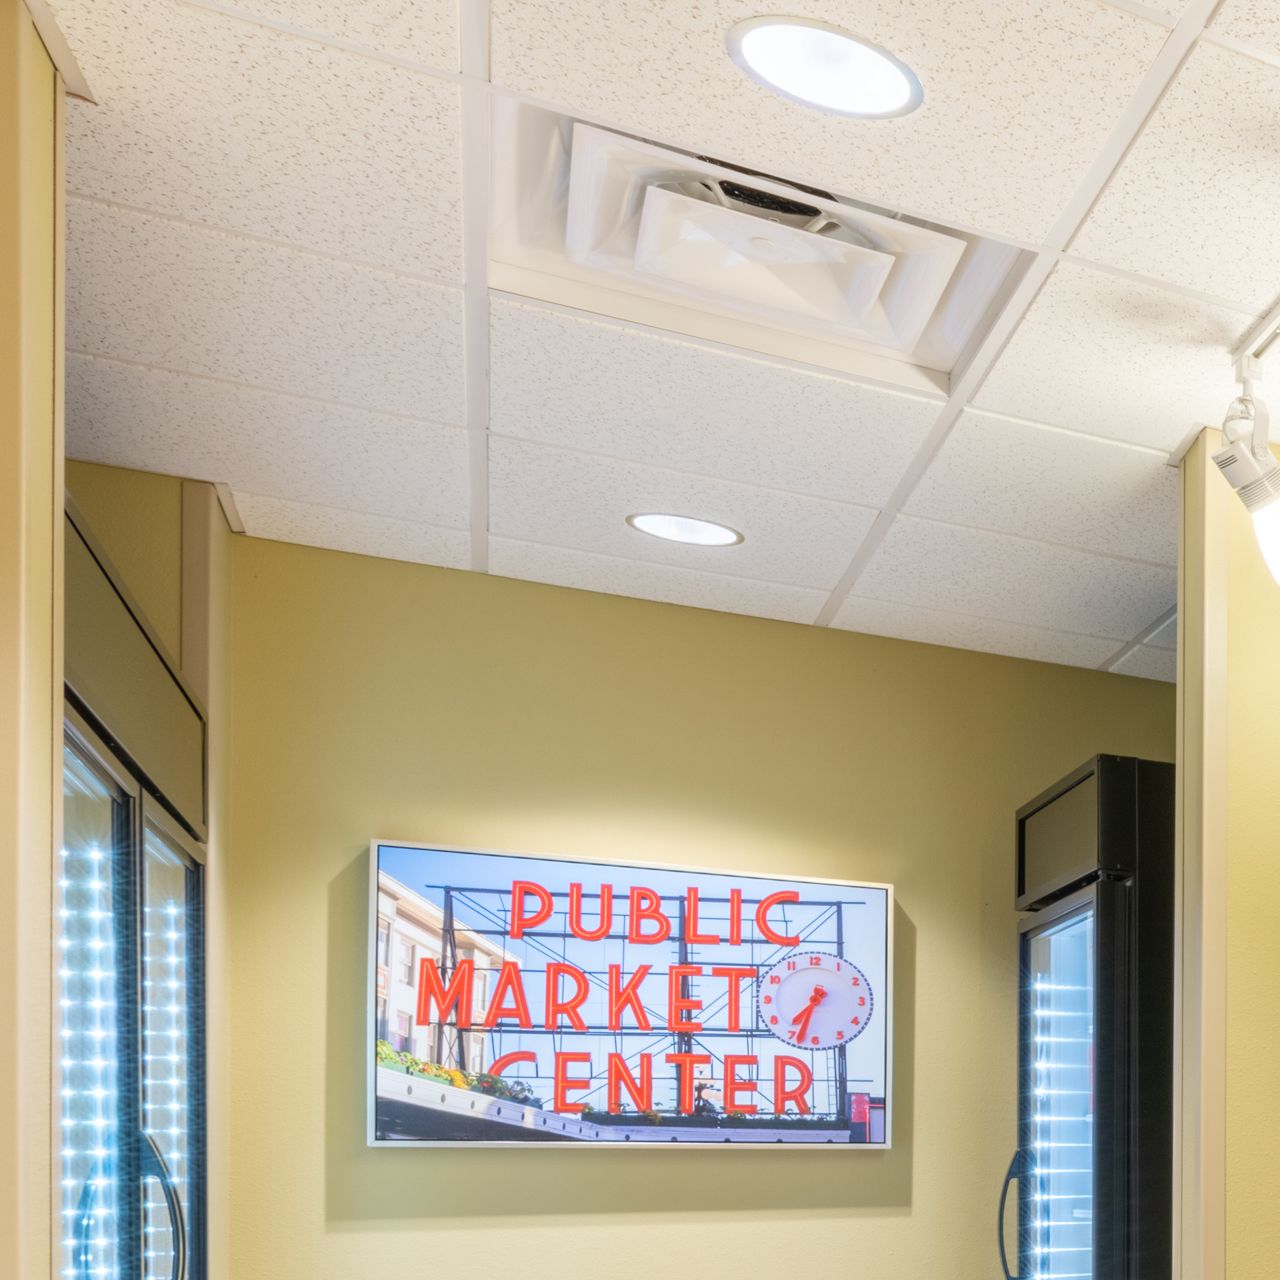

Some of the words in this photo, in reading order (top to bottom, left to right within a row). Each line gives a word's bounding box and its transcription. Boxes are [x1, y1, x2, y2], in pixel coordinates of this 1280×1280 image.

[509, 880, 802, 946] PUBLIC
[787, 961, 796, 970] 11
[810, 957, 820, 966] 12
[837, 963, 840, 971] 1
[770, 975, 780, 984] 10
[853, 977, 859, 986] 2
[416, 957, 758, 1033] MARKET
[764, 995, 772, 1004] 9
[858, 997, 865, 1006] 3
[770, 1015, 778, 1025] 8
[851, 1017, 859, 1025] 4
[788, 1031, 796, 1039] 7
[836, 1031, 844, 1040] 5
[811, 1036, 819, 1045] 6
